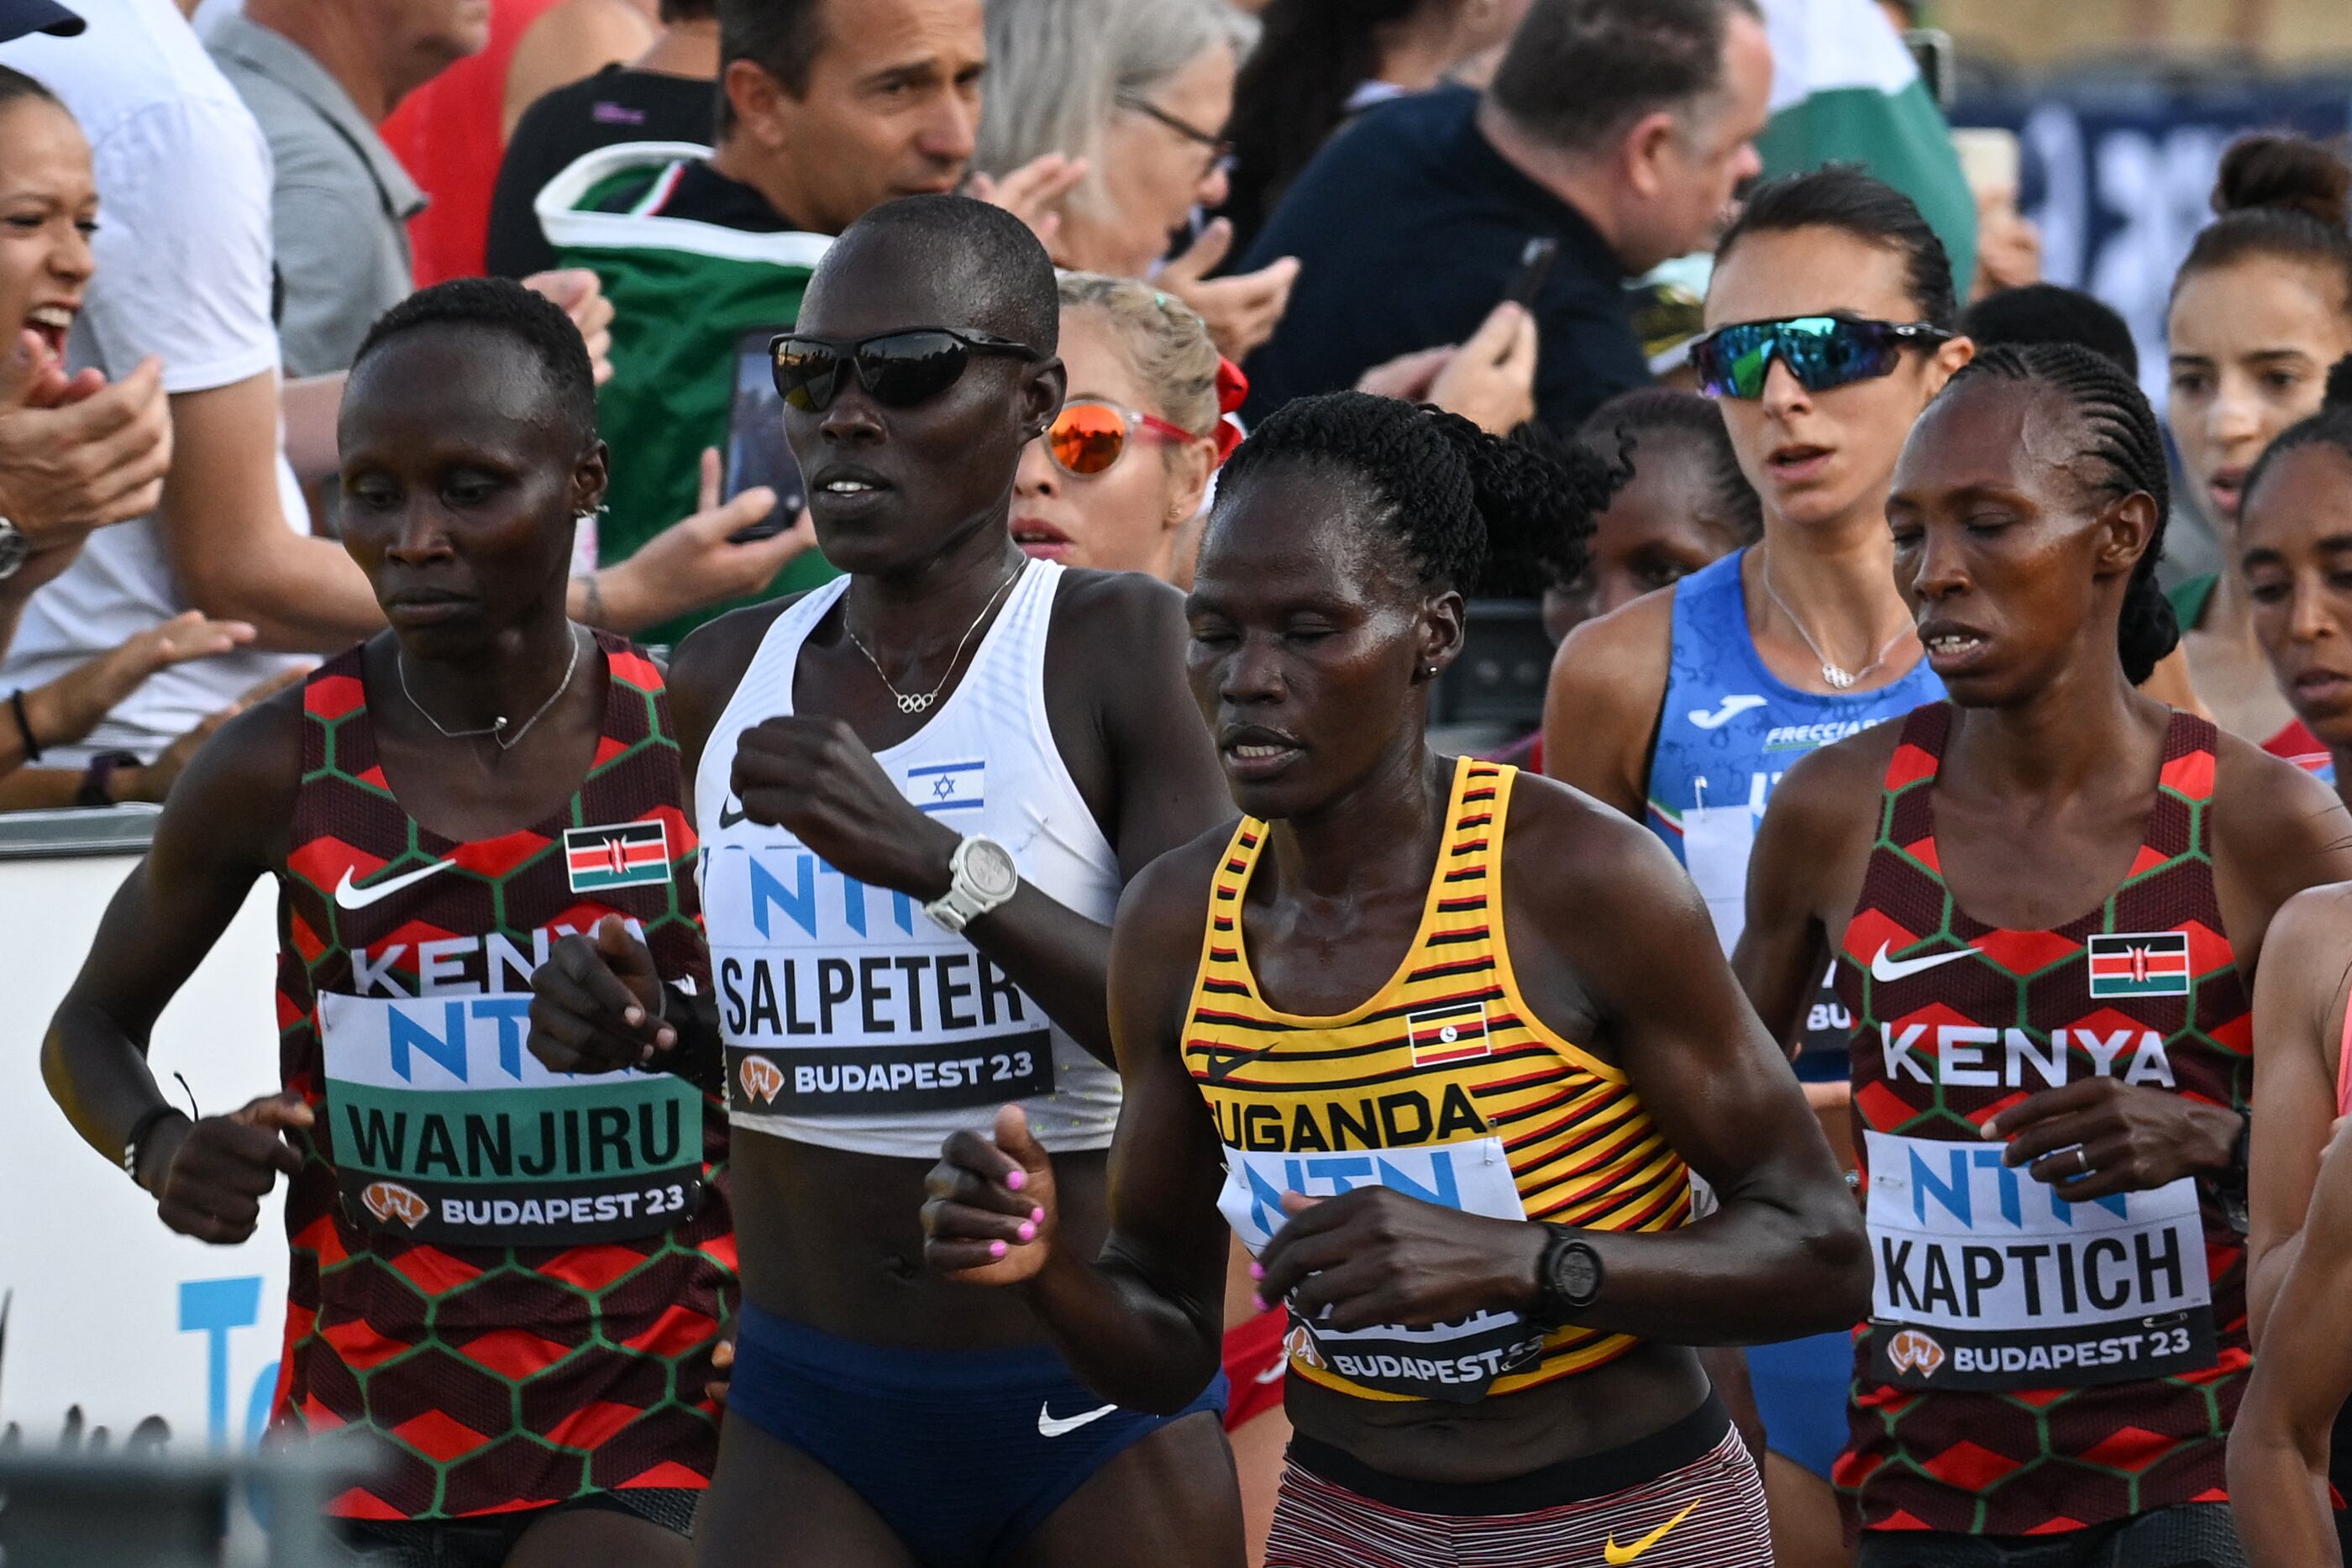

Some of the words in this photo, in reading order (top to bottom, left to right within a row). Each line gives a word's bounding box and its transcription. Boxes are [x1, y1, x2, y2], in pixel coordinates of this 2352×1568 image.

[350, 918, 648, 998] KEN
[722, 952, 1025, 1036] SALPETER
[388, 1000, 630, 1083] NT
[795, 1057, 983, 1093] BUDAPEST
[990, 1051, 1034, 1081] 23
[1880, 1022, 2176, 1088] KENYA
[345, 1099, 680, 1177] WANJIRU
[1215, 1083, 1487, 1153] UGANDA
[441, 1193, 641, 1225] BUDAPEST
[646, 1184, 685, 1214] 23
[1882, 1227, 2183, 1318] KAPTICH
[1332, 1348, 1504, 1384] BUDAPEST
[1954, 1335, 2143, 1372] BUDAPEST
[2150, 1327, 2191, 1358] 23
